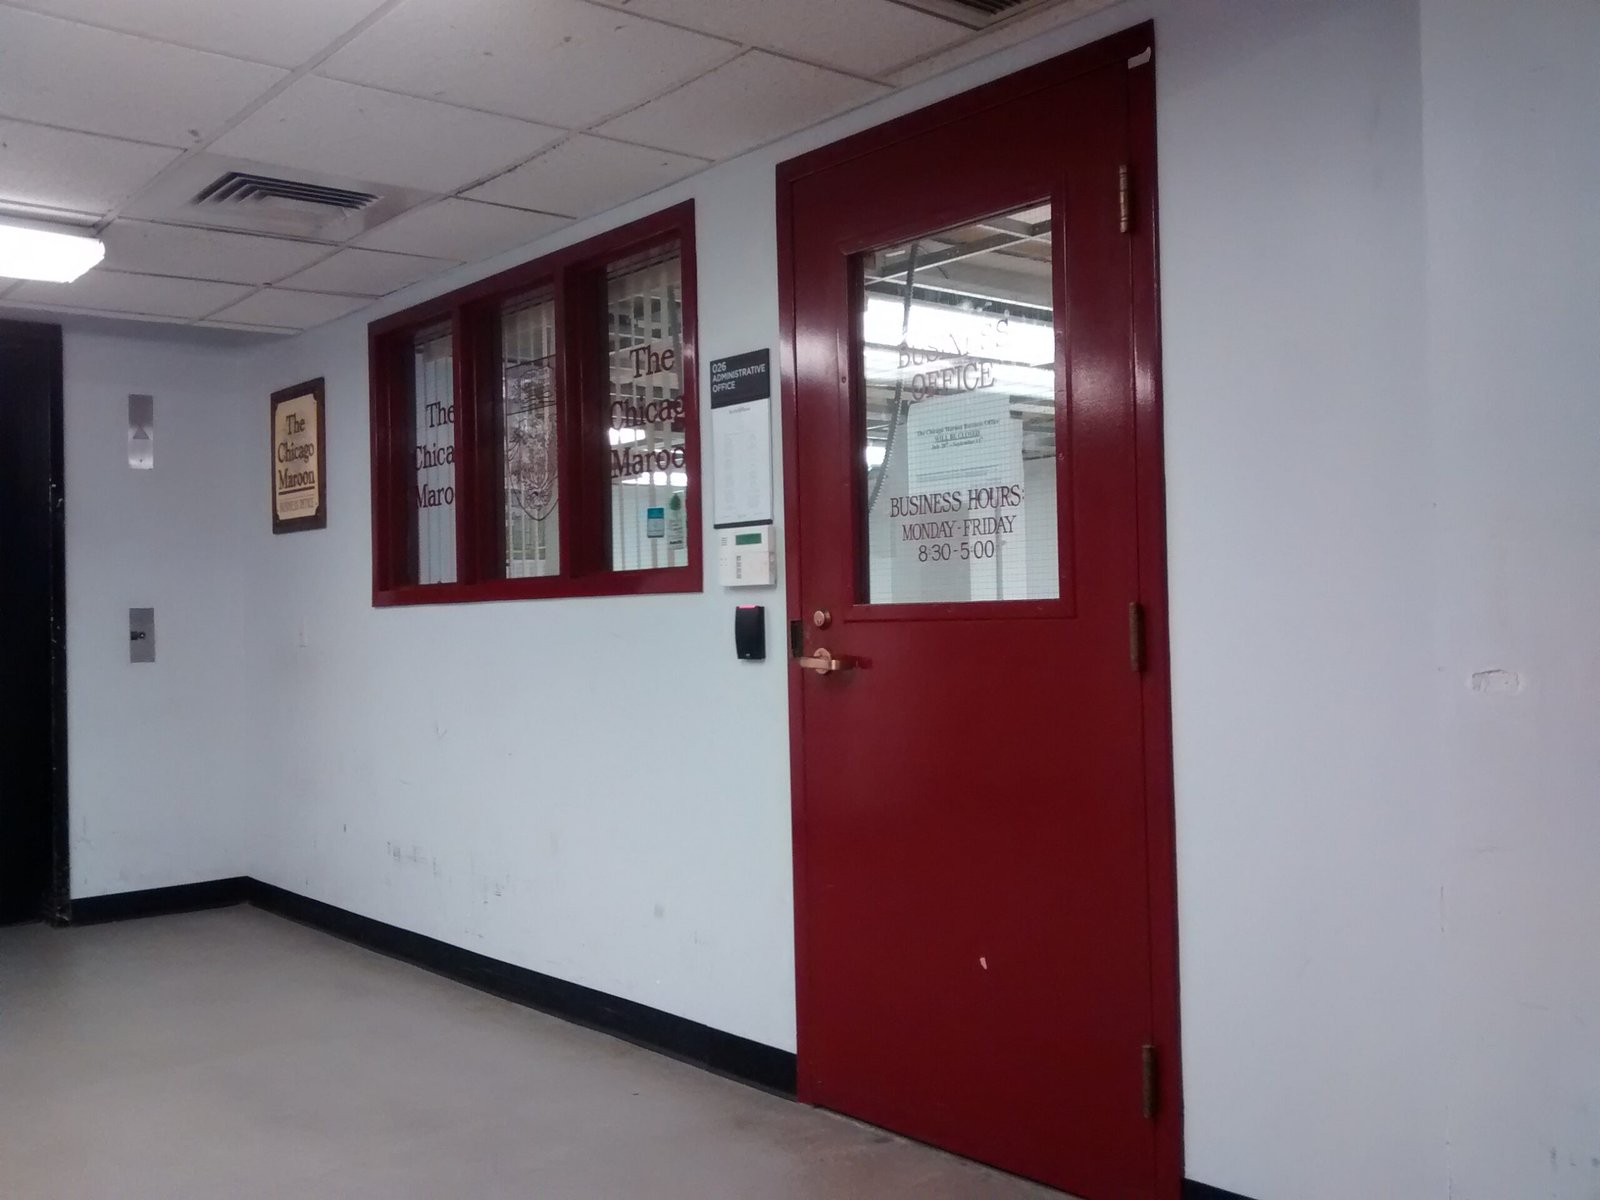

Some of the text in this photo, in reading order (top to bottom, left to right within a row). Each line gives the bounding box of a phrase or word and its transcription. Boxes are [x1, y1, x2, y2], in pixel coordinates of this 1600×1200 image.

[630, 345, 675, 378] The
[712, 363, 766, 382] ADMINISTRATIVE
[712, 380, 736, 393] OFFICE
[911, 361, 995, 401] OFFICE
[286, 412, 305, 435] The
[426, 401, 455, 428] The
[277, 440, 315, 464] Chicago
[415, 443, 455, 472] Chica
[610, 446, 685, 478] Maroo
[278, 468, 316, 491] Maroon
[416, 483, 455, 510] Maro
[890, 490, 962, 518] BUSINESS
